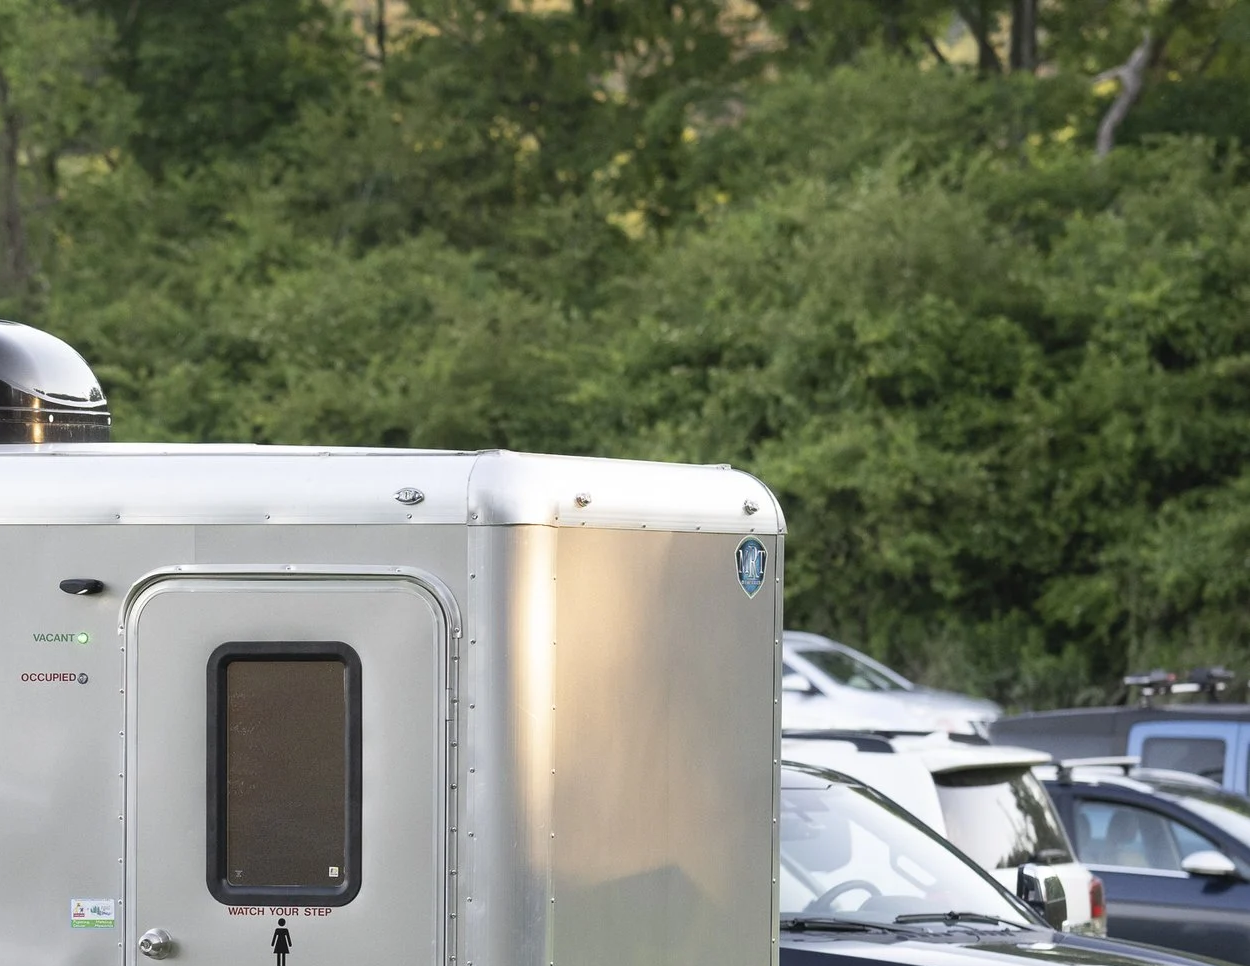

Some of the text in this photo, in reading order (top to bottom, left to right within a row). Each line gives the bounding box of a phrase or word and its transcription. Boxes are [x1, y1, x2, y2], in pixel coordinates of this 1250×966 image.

[33, 633, 75, 642] VACANT
[21, 673, 77, 682] OCCUPIED
[228, 906, 332, 917] WATCH YOUR STEP
